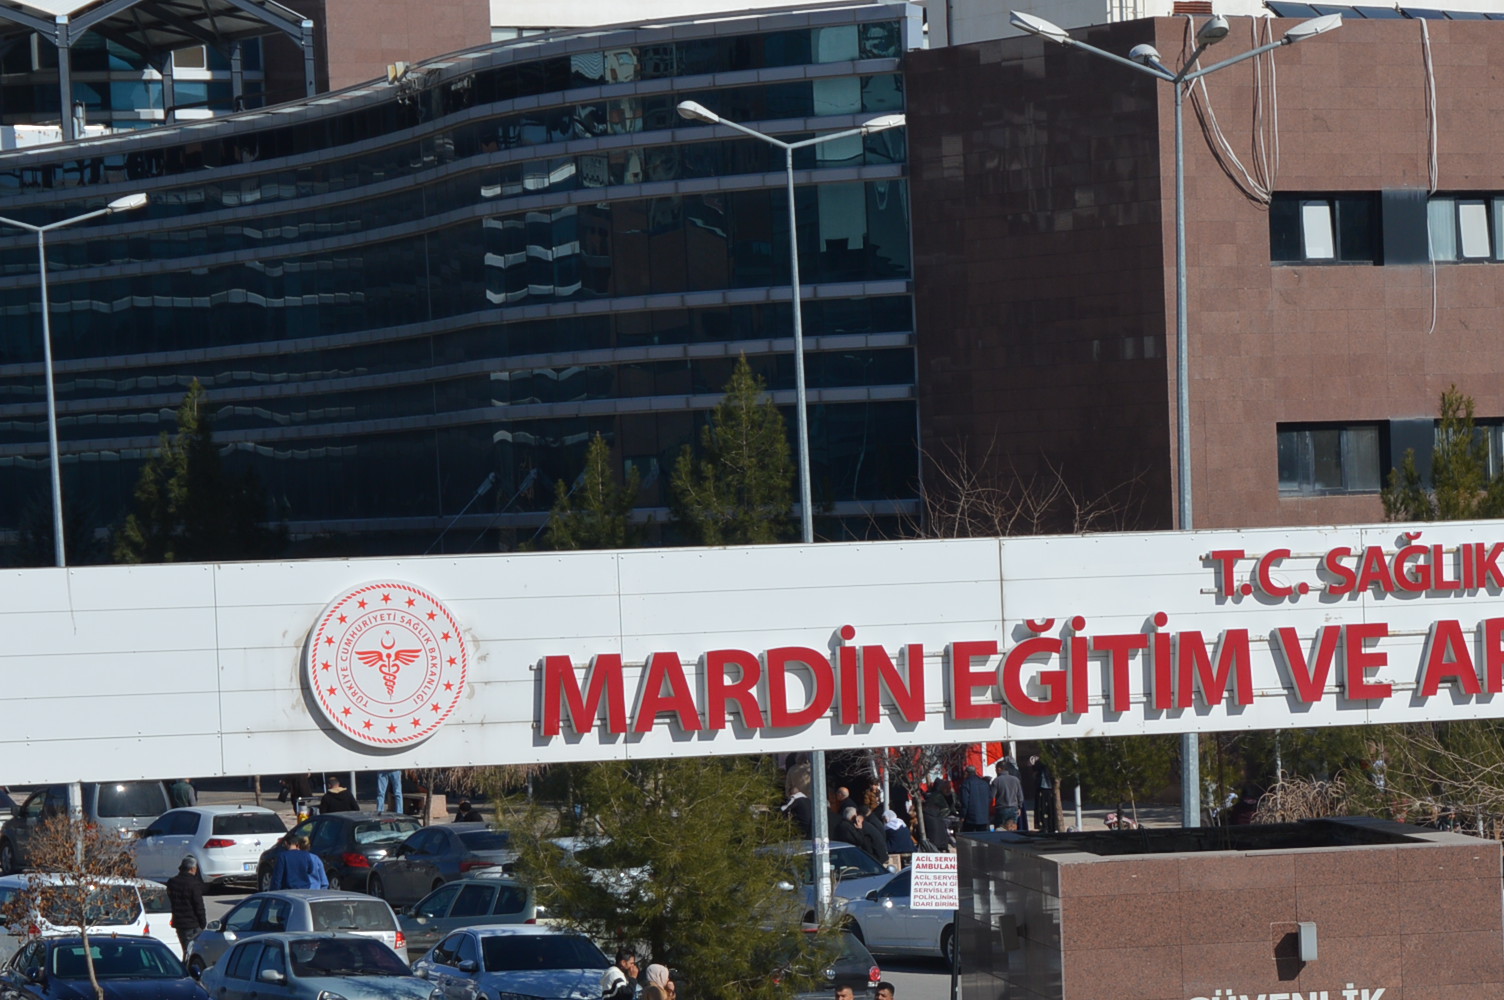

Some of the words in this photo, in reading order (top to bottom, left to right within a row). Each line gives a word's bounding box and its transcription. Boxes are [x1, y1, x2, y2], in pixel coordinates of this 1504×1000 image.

[1210, 549, 1311, 597] T.C.
[340, 612, 397, 662] CUMHURİYETİ
[400, 615, 432, 645] SAĞLIK
[341, 666, 369, 708] TÜRKİYE
[413, 647, 438, 705] BAKANLIĞI
[542, 625, 927, 738] MARDİN
[952, 610, 1255, 721] EĞİTİM
[1277, 622, 1393, 703] VE
